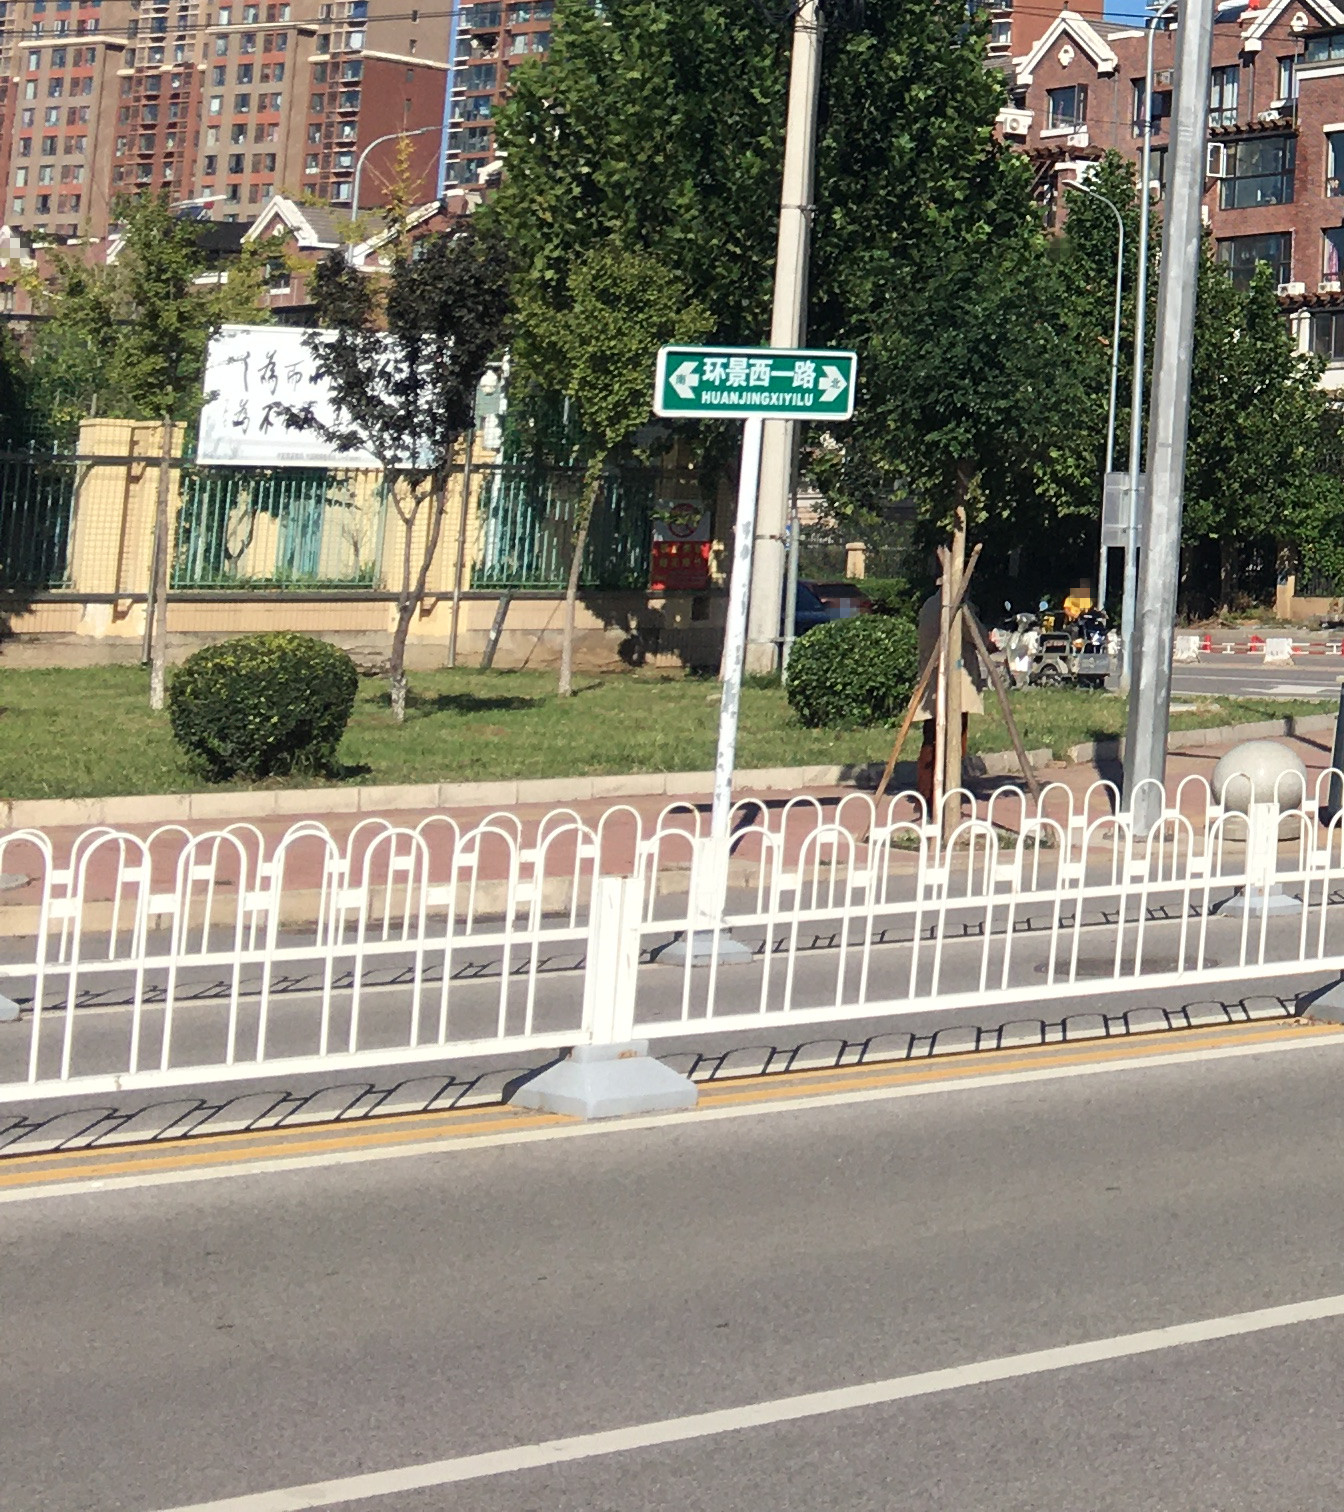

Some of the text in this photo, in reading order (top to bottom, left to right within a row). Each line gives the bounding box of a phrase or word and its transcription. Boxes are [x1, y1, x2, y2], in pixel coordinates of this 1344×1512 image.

[702, 357, 817, 389] 环景西一路
[701, 390, 814, 407] HUANJINGXIYILU
